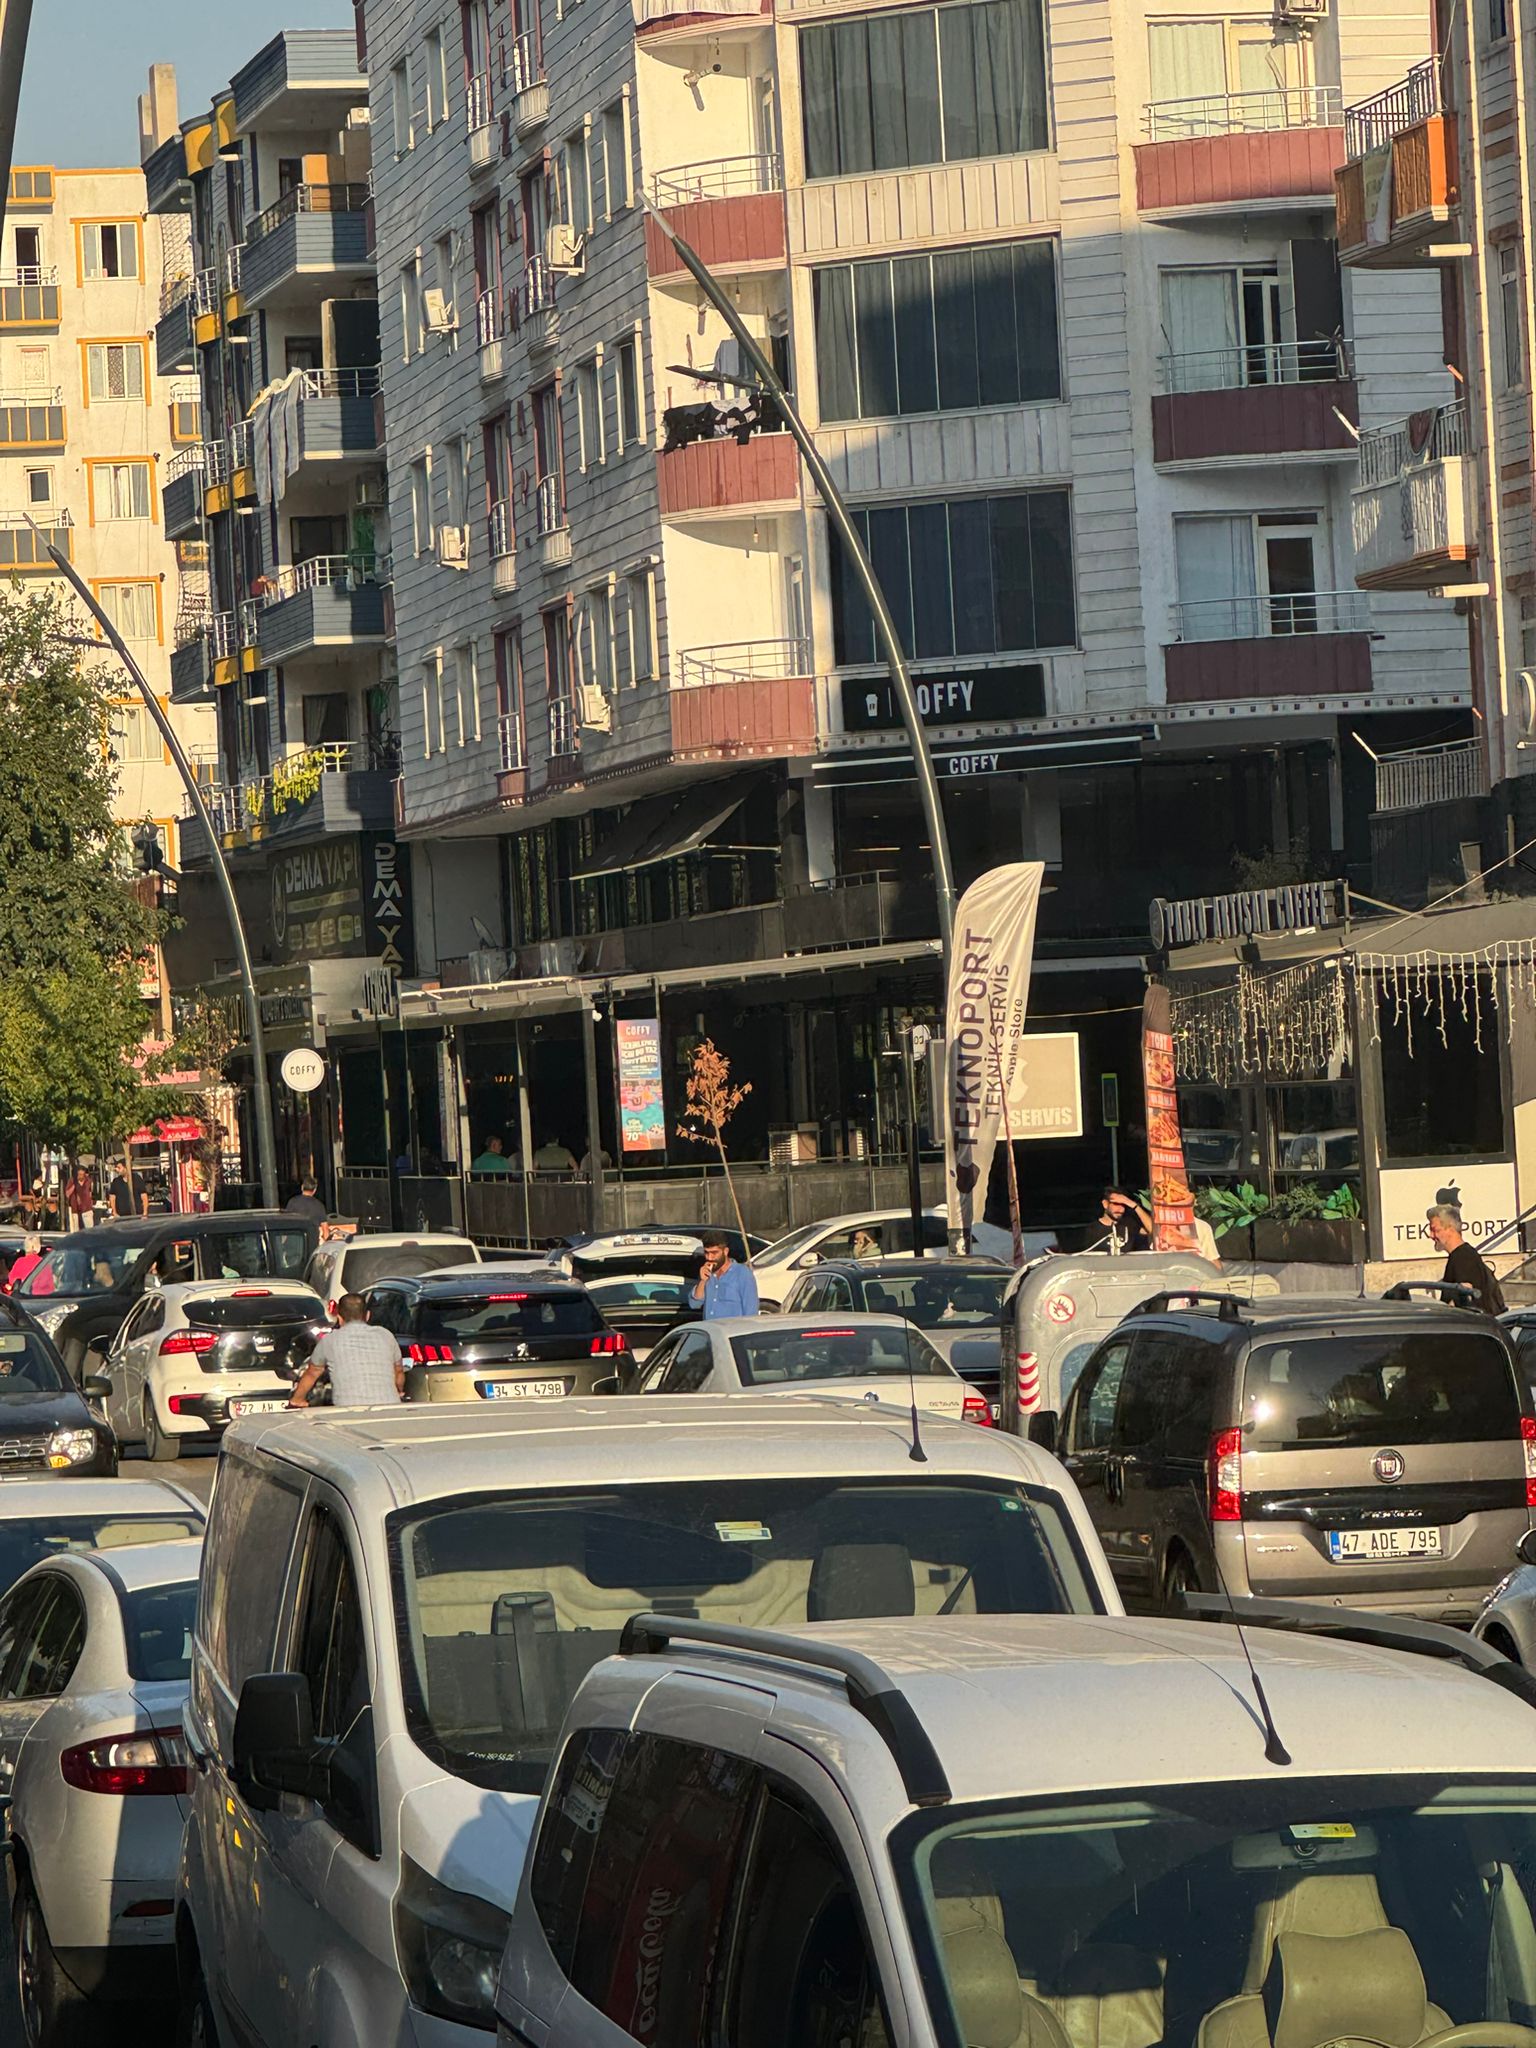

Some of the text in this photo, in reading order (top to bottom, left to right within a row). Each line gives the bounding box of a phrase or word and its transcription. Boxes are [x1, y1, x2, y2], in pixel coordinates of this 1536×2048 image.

[916, 680, 975, 716] OFFY
[949, 754, 1000, 775] COFFY
[285, 841, 359, 894] DEMA YAPI
[373, 842, 403, 918] DEMA
[1276, 881, 1329, 930] COFFEE
[625, 1025, 650, 1036] COFFY
[1008, 998, 1024, 1039] Store
[954, 928, 993, 1151] TEKNOPORT
[984, 964, 1010, 1119] TEKNİK SERVİS
[290, 1065, 316, 1076] COFFY
[1393, 1219, 1508, 1241] TEKPORT
[494, 1383, 562, 1398] 34 SY 4798
[1341, 1530, 1438, 1552] 47 ADE 795
